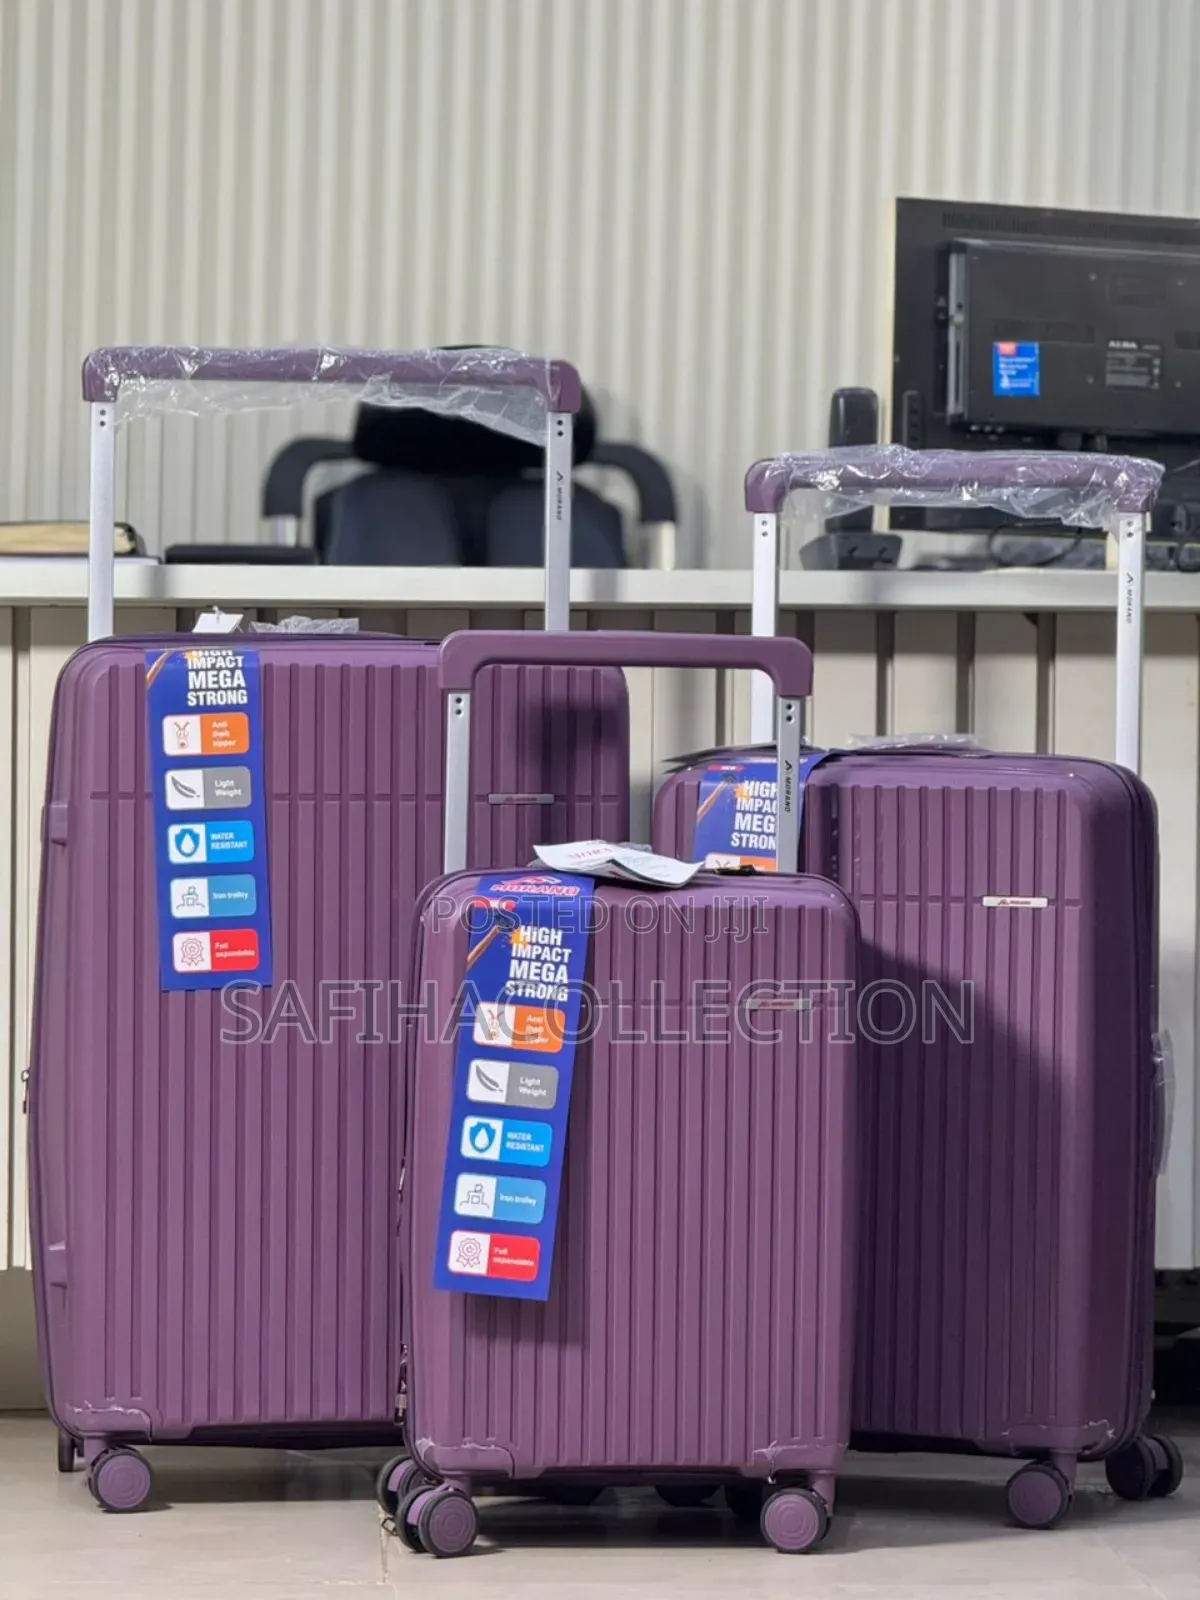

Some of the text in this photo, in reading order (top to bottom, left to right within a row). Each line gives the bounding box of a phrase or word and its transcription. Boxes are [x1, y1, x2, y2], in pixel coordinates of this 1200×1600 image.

[187, 656, 244, 669] IMPACT
[188, 670, 246, 690] MEGA
[187, 690, 248, 706] STRONG
[215, 779, 235, 788] Light
[215, 788, 242, 797] Weight
[736, 797, 776, 814] IMPA
[734, 812, 776, 833] MEG
[210, 832, 234, 840] WATER
[730, 832, 776, 850] STRON
[211, 840, 248, 849] RESISTANT
[511, 943, 572, 963] IMPACT
[509, 959, 568, 984] MEGA
[505, 980, 568, 1002] STRONG
[520, 1077, 541, 1087] Light
[518, 1086, 547, 1097] Weight
[506, 1131, 532, 1141] WATER
[505, 1141, 544, 1152] RESISTANT
